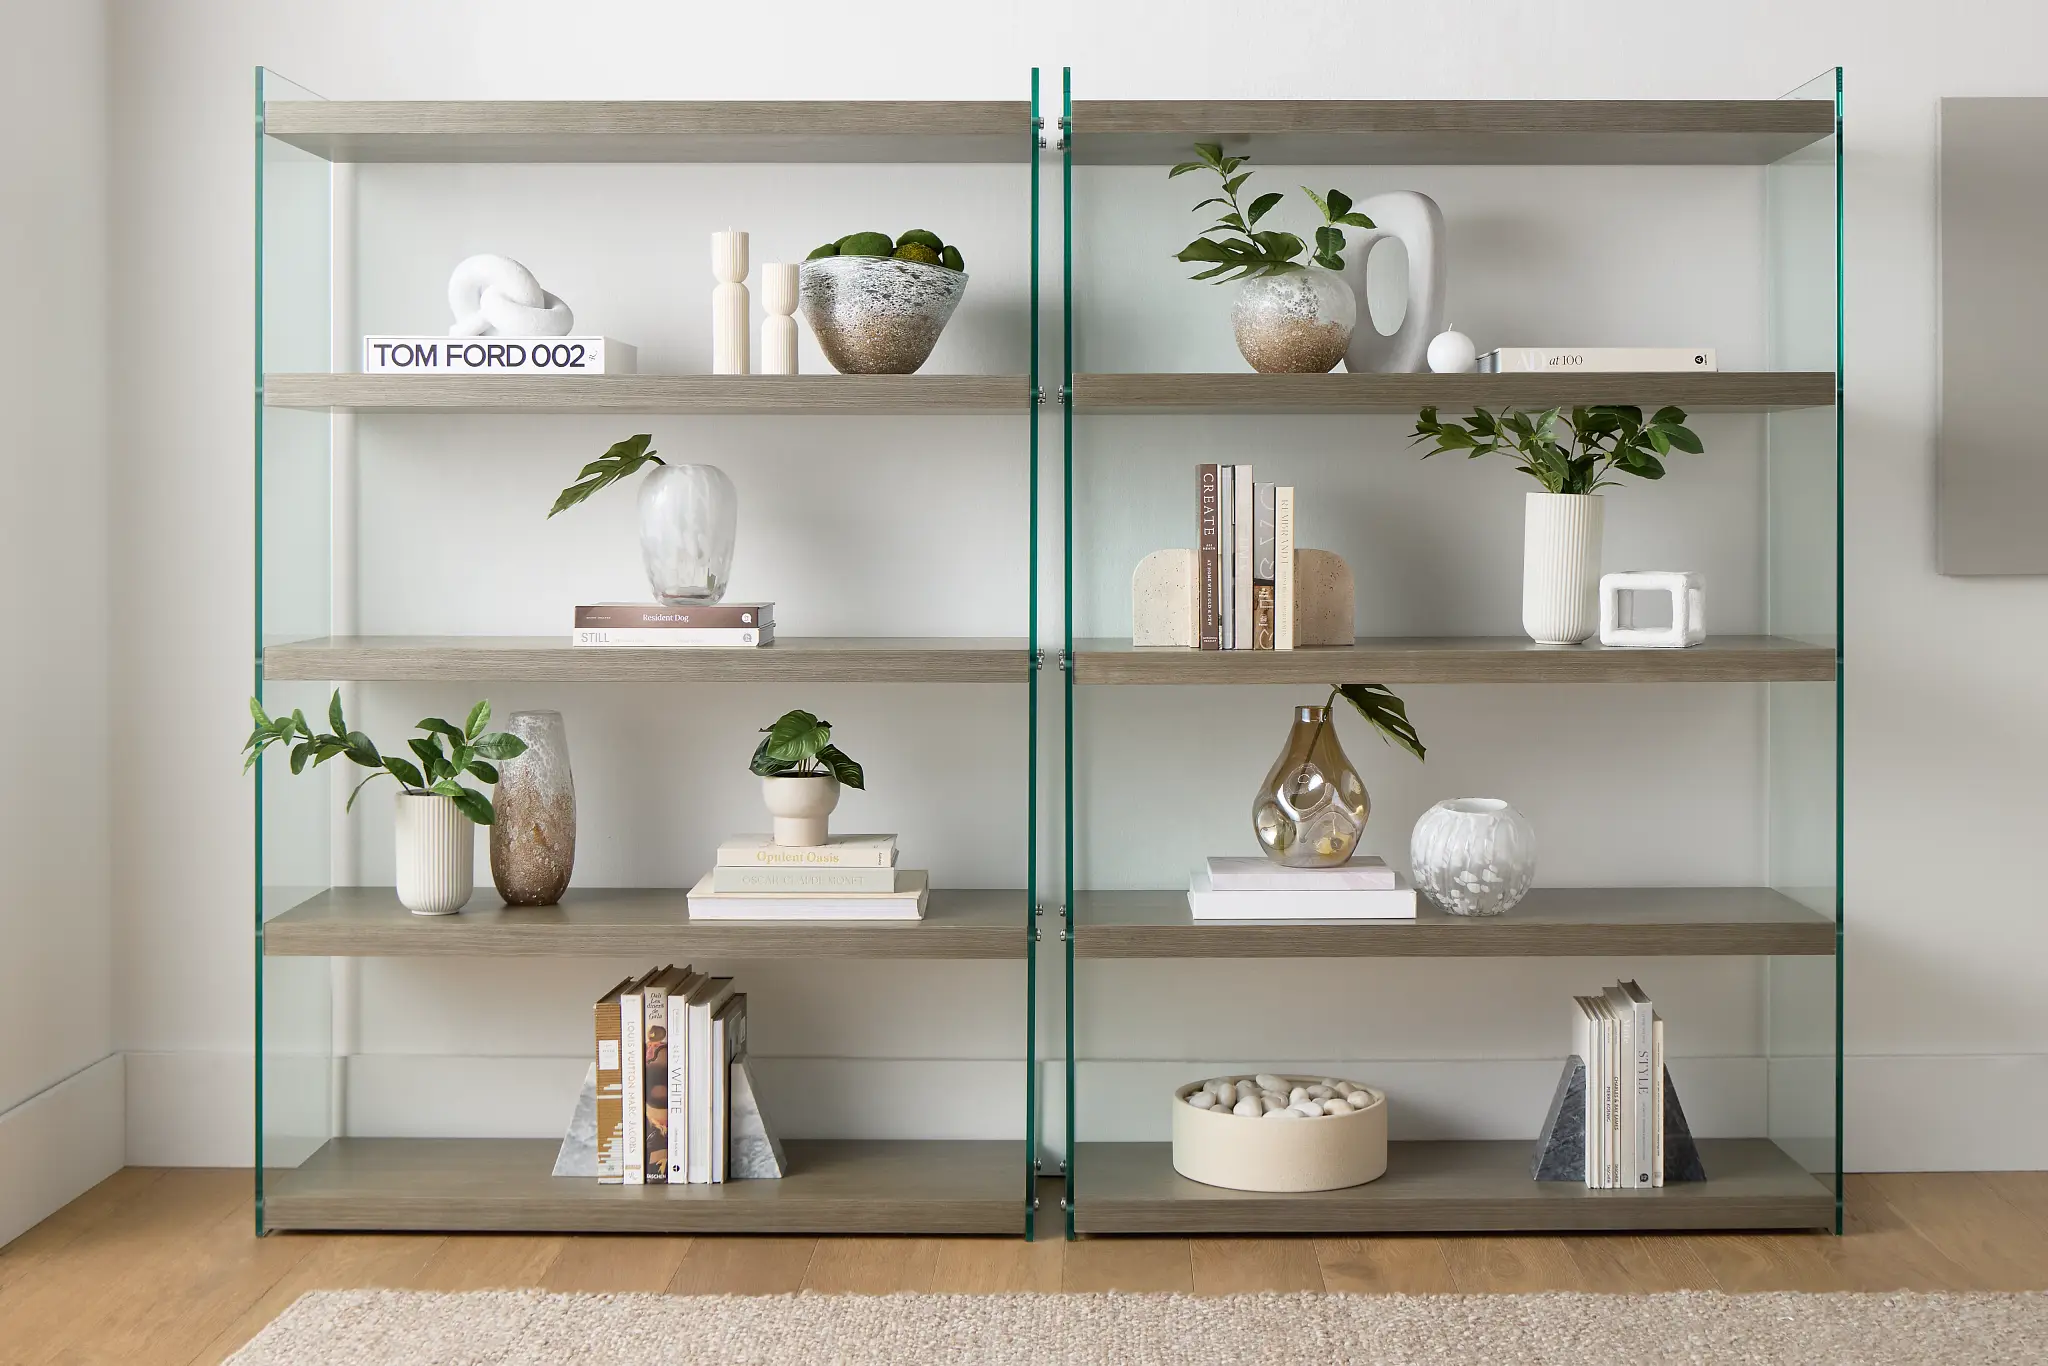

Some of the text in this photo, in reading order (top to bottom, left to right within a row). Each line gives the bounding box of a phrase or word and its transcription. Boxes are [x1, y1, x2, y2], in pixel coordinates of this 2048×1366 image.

[373, 343, 438, 367] TOM
[446, 343, 527, 367] FORD
[531, 343, 586, 367] 002
[1549, 355, 1560, 366] at
[1562, 355, 1583, 366] 100
[1203, 473, 1215, 536] CREATE
[643, 614, 689, 623] Resident Dog
[581, 633, 610, 643] STILL
[757, 851, 839, 865] Opulent Oasis
[742, 875, 864, 886] OSCAR CLAUDE MONET
[1638, 1050, 1649, 1095] STYLE
[626, 1021, 636, 1154] LOUIS VUITTON MARC JACOBS
[671, 1067, 682, 1114] WHITE
